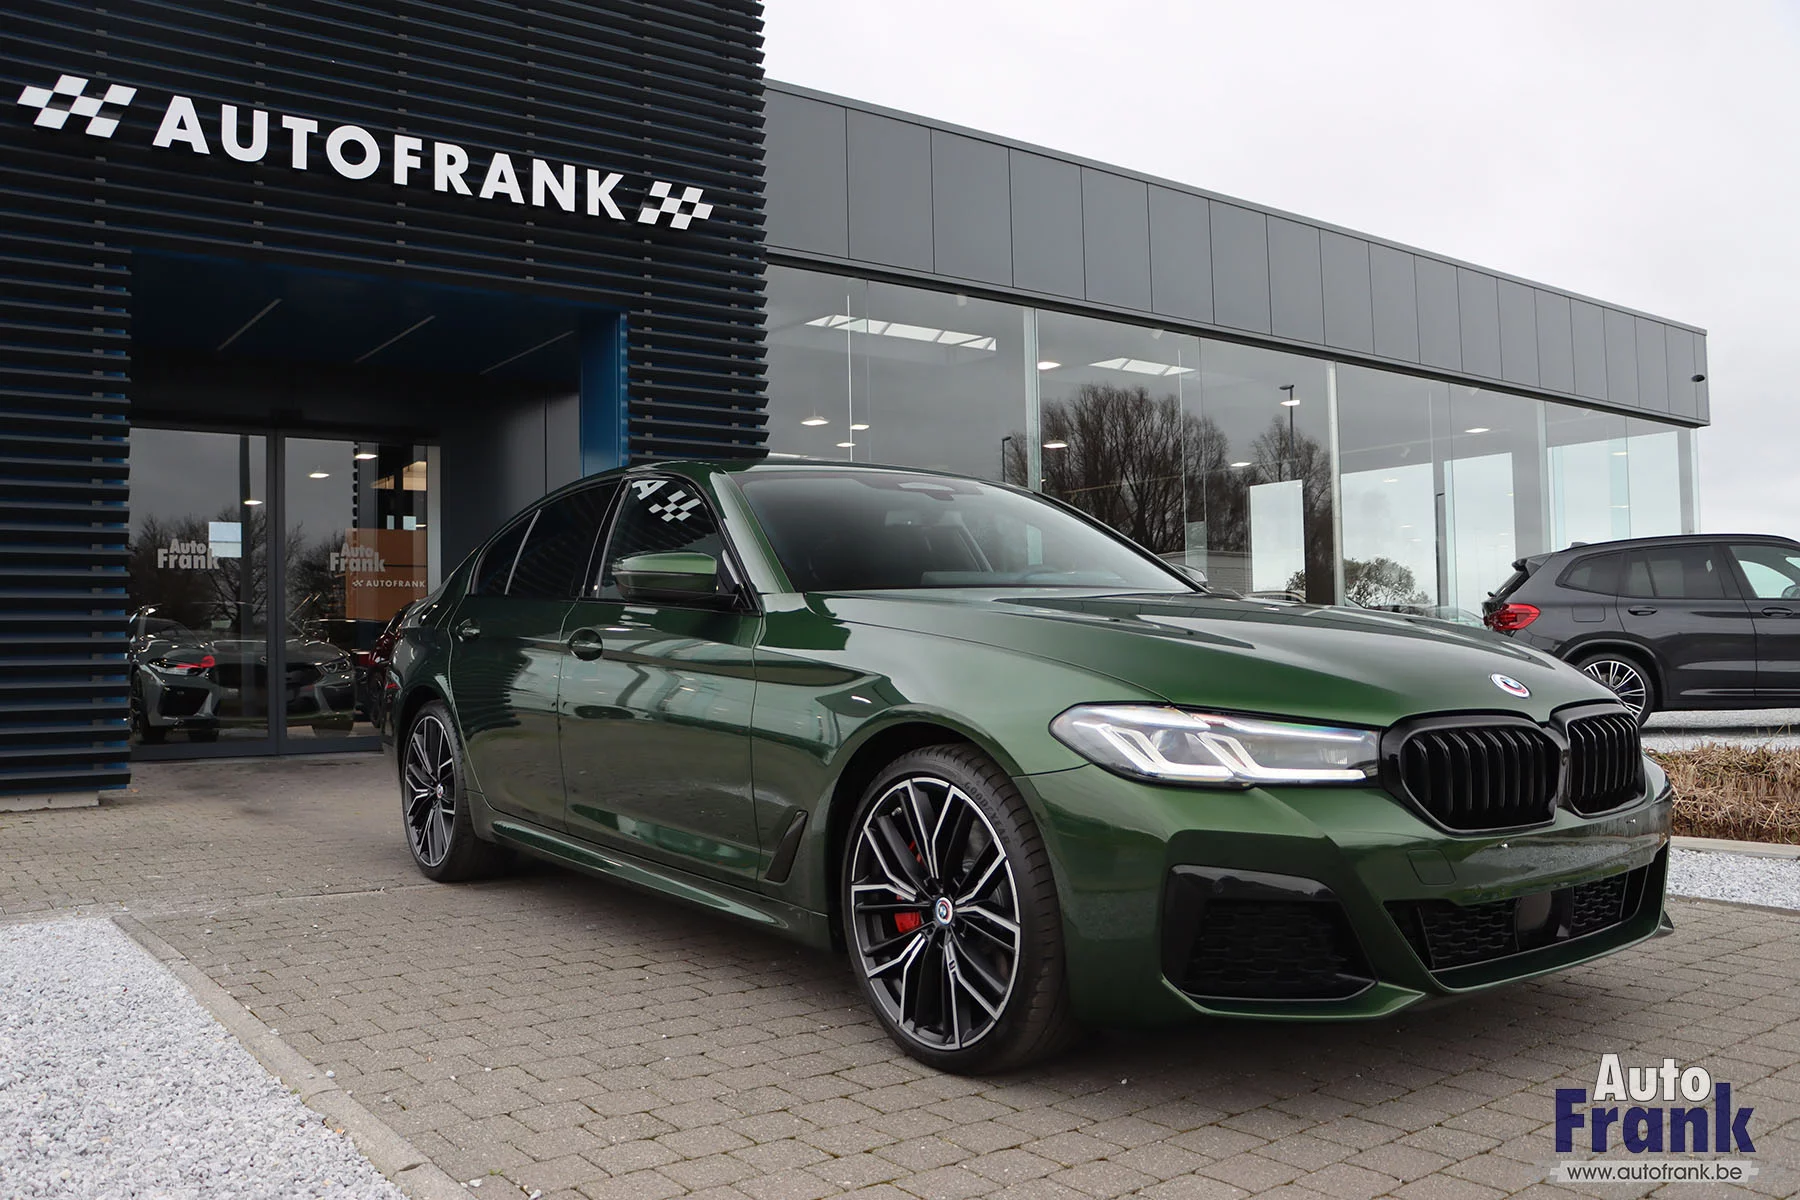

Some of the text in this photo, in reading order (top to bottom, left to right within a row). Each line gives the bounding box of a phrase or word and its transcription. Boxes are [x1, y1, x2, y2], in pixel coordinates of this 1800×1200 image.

[152, 96, 625, 221] AUTOFRANK
[169, 538, 207, 554] Auto
[341, 542, 375, 558] Auto
[157, 547, 220, 569] Frank
[330, 551, 386, 572] Frank
[365, 579, 426, 588] AUTOFRANK
